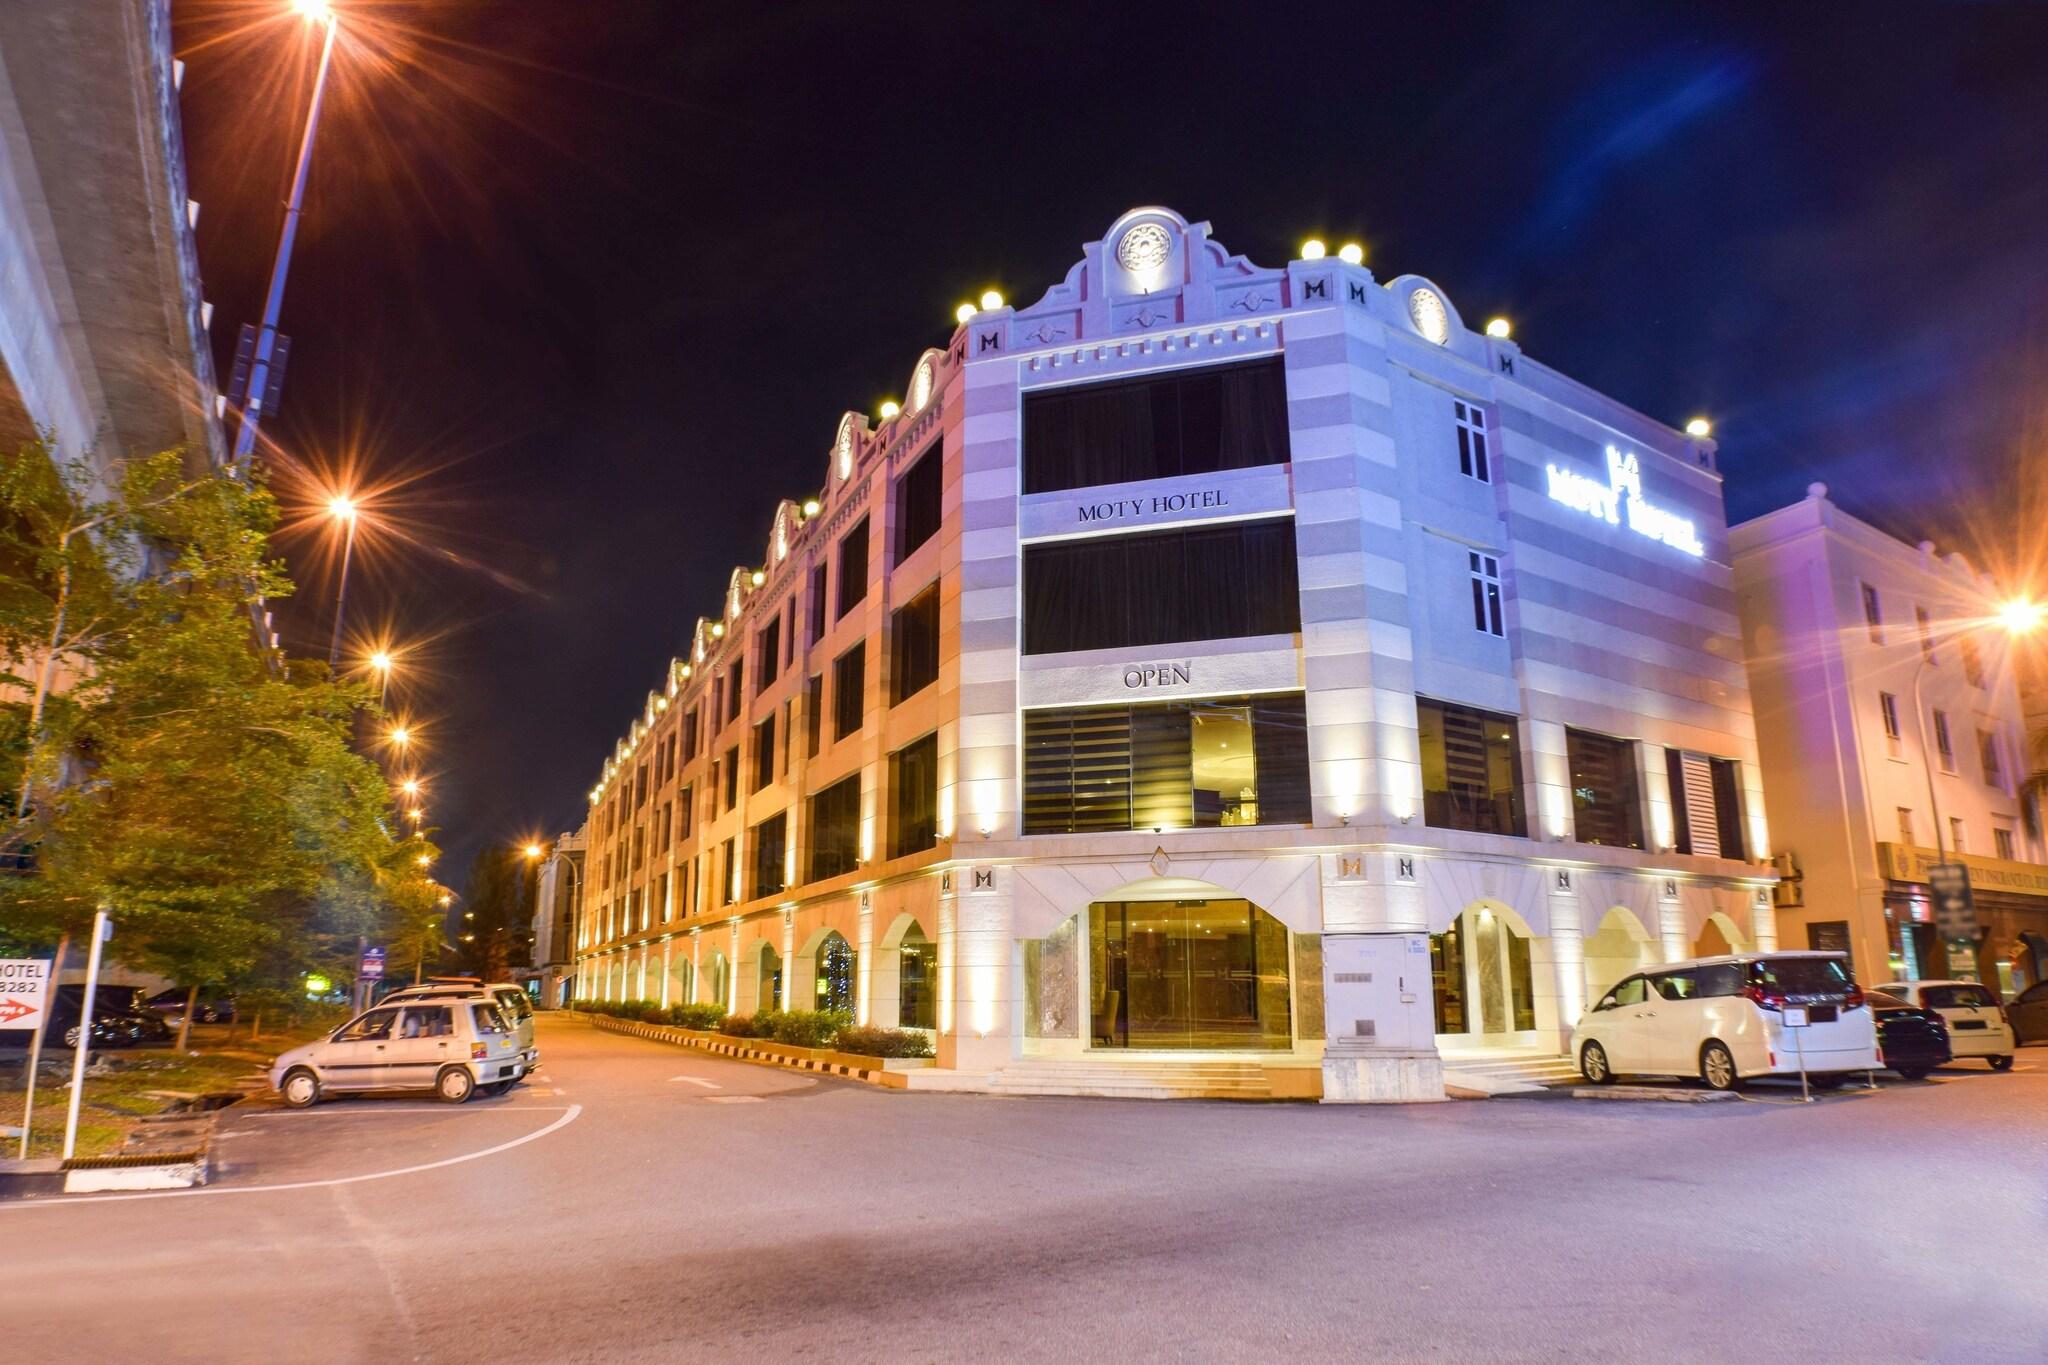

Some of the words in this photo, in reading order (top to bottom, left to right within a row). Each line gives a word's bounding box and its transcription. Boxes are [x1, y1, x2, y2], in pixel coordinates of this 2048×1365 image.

[1079, 499, 1144, 522] MOTY
[1152, 490, 1228, 513] HOTEL
[1124, 666, 1190, 689] OPEN
[975, 870, 992, 888] M
[0, 964, 43, 977] OTEL
